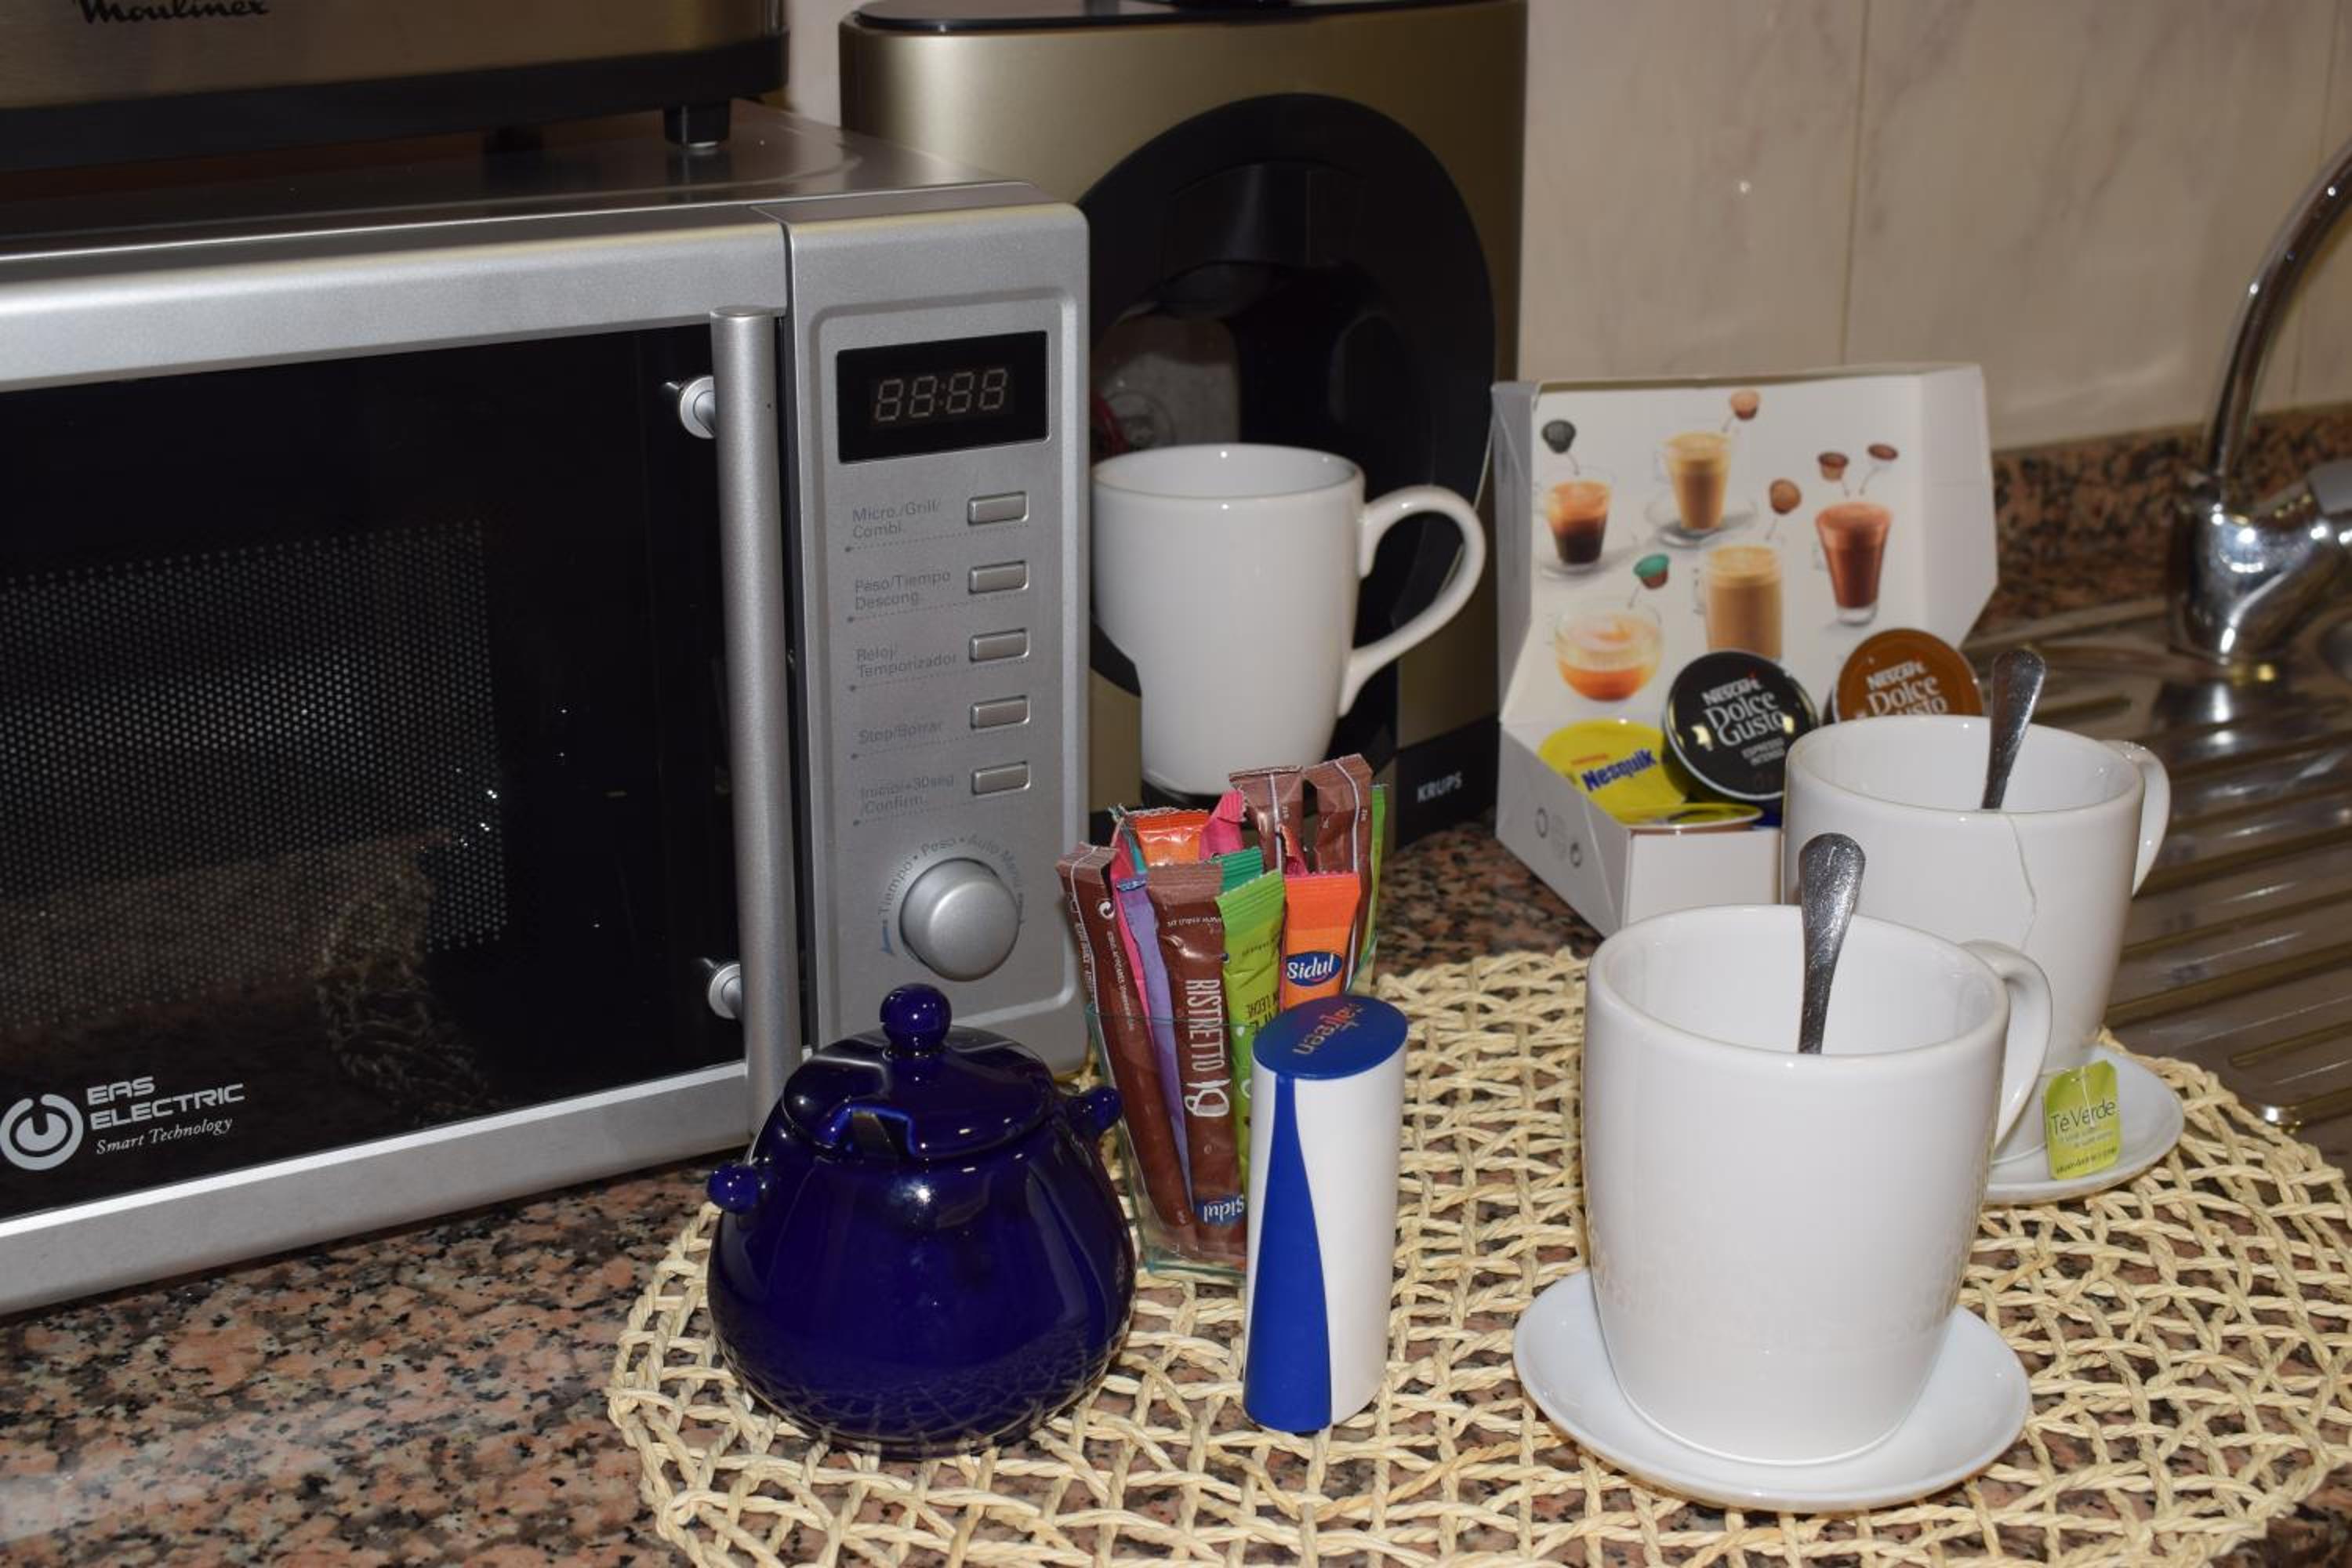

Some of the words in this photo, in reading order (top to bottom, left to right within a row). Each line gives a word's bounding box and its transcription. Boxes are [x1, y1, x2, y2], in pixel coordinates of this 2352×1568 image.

[1704, 691, 1778, 731] Dolce
[1867, 675, 1940, 715] Dolce
[1717, 710, 1785, 746] Gusto
[1581, 748, 1657, 793] Nesquik
[1287, 953, 1334, 980] Sidul
[1185, 978, 1225, 1072] RISTRETTO
[85, 1076, 155, 1106] EAS
[89, 1083, 245, 1131] ELECTRIC
[96, 1134, 145, 1155] Smart
[148, 1116, 234, 1145] Technology
[1203, 1193, 1245, 1224] Sidul
